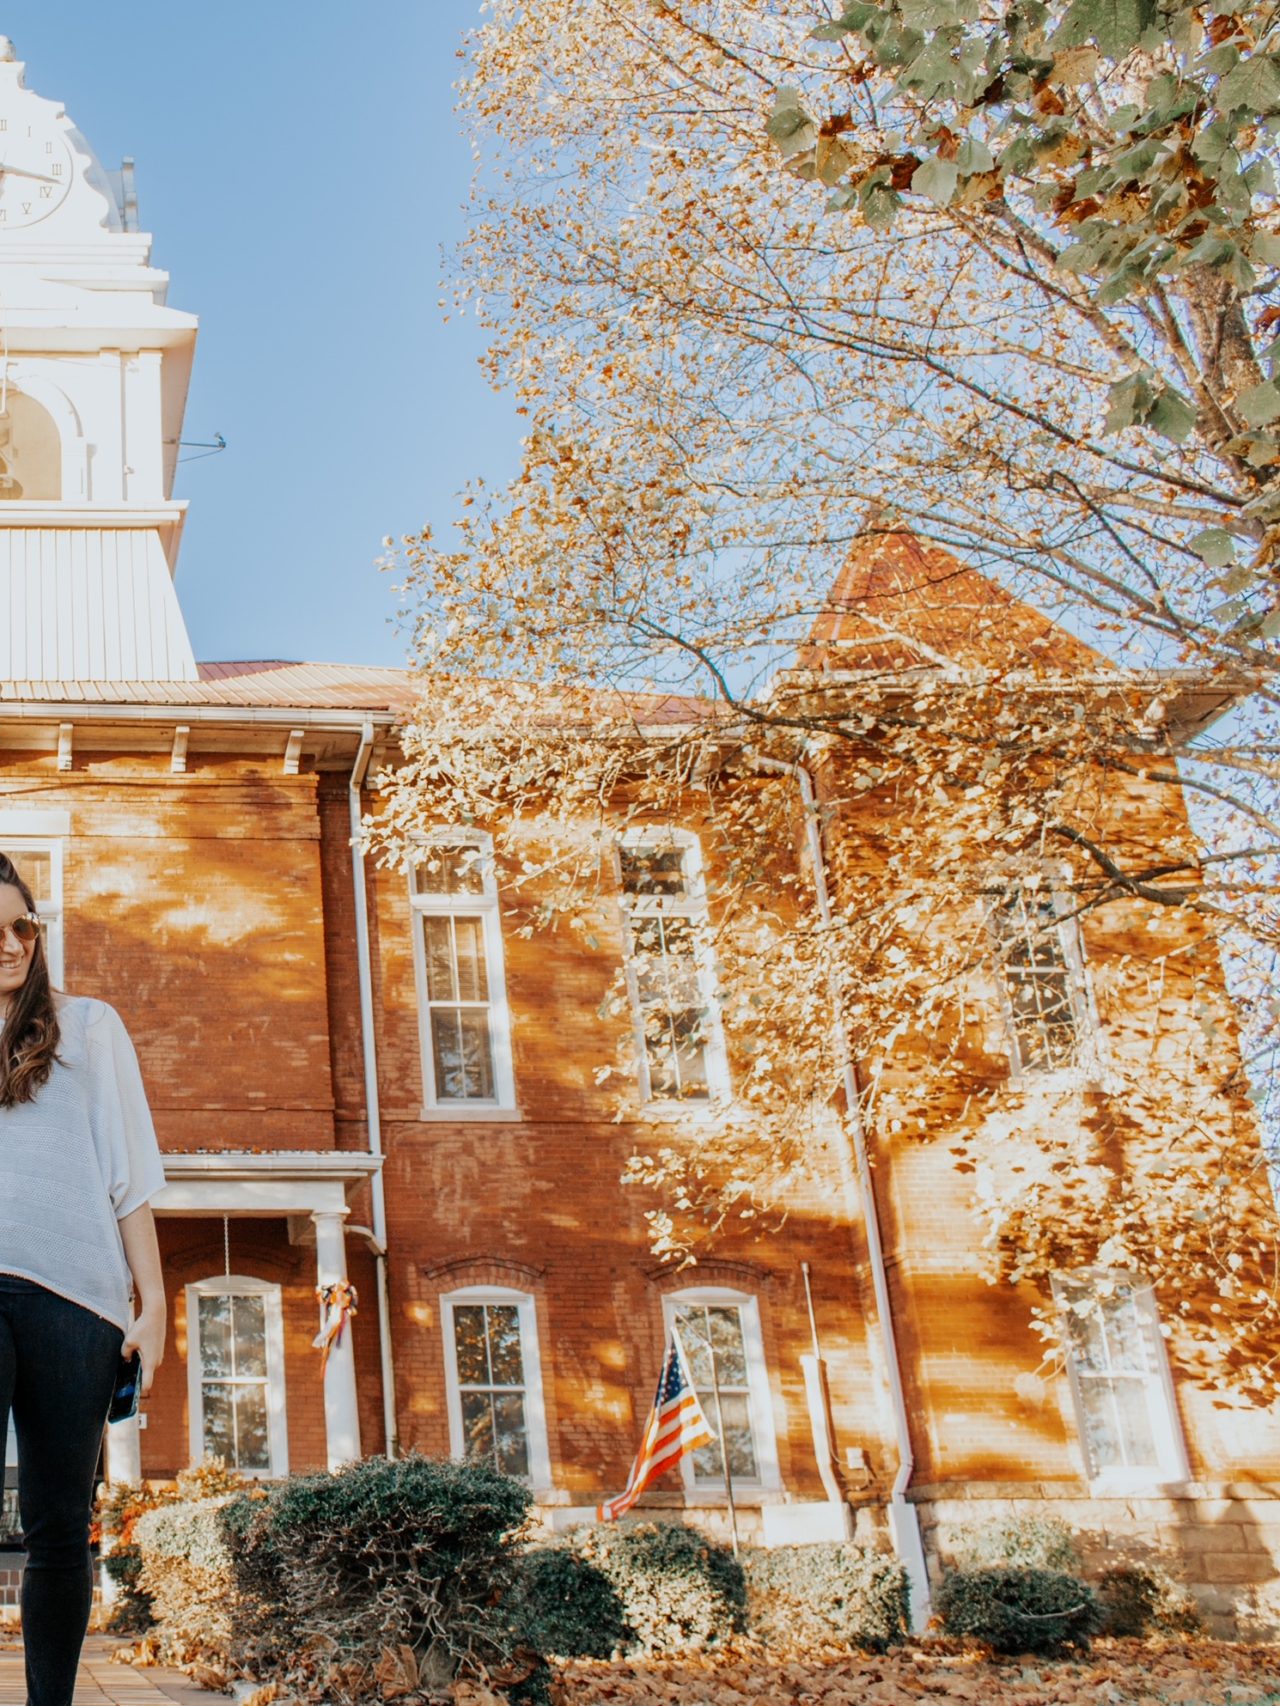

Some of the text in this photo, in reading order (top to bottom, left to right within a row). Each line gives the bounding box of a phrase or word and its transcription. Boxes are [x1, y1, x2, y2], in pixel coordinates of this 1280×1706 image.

[27, 126, 32, 137] I
[46, 142, 52, 154] II
[52, 163, 62, 176] III
[39, 186, 52, 198] IV
[22, 202, 32, 214] V
